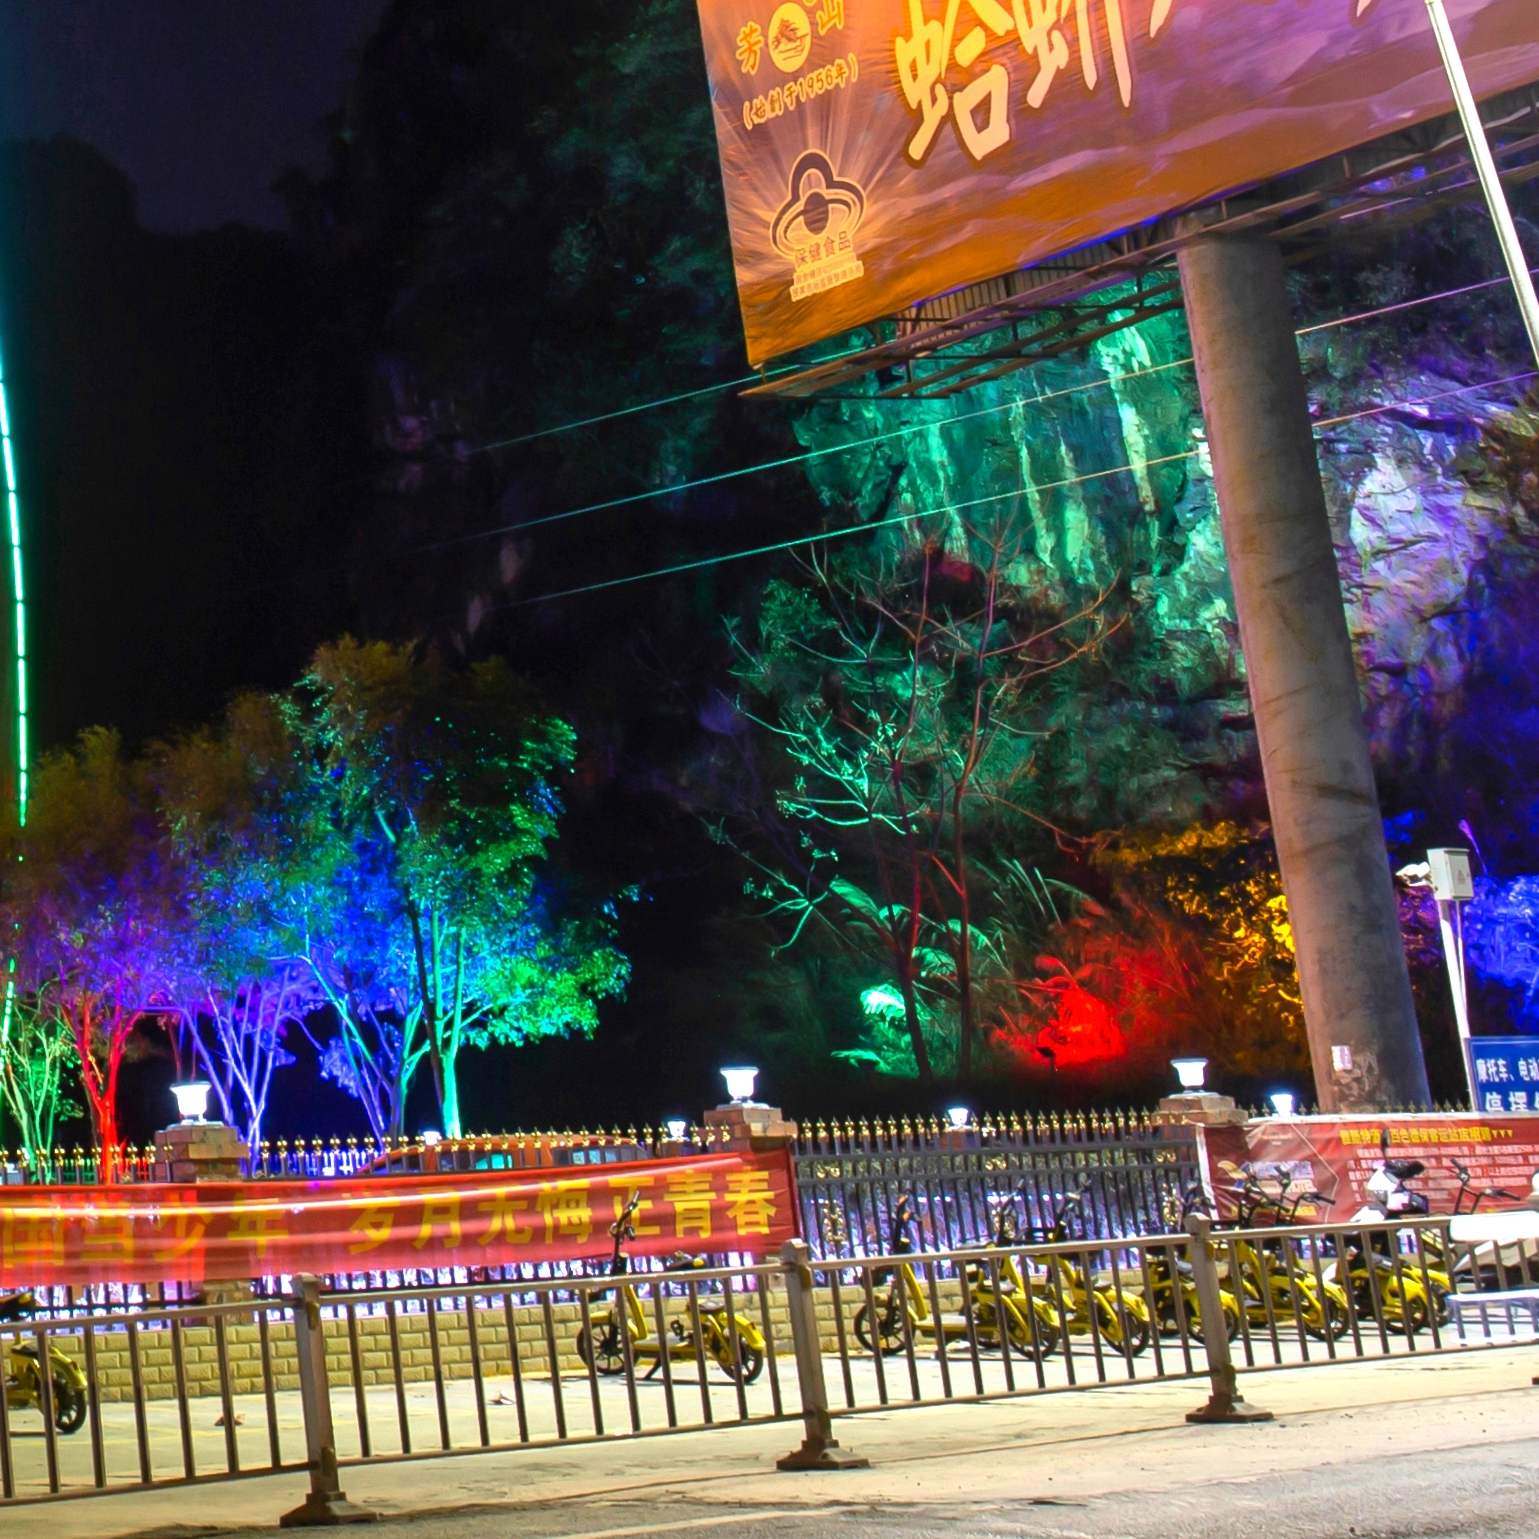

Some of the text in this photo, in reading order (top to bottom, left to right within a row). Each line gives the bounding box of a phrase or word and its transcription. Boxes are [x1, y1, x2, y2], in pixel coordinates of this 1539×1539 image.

[794, 229, 852, 269] 保健食品
[1475, 1057, 1539, 1083] 摩托车、电动
[344, 1167, 778, 1256] 岁月无悔正青春
